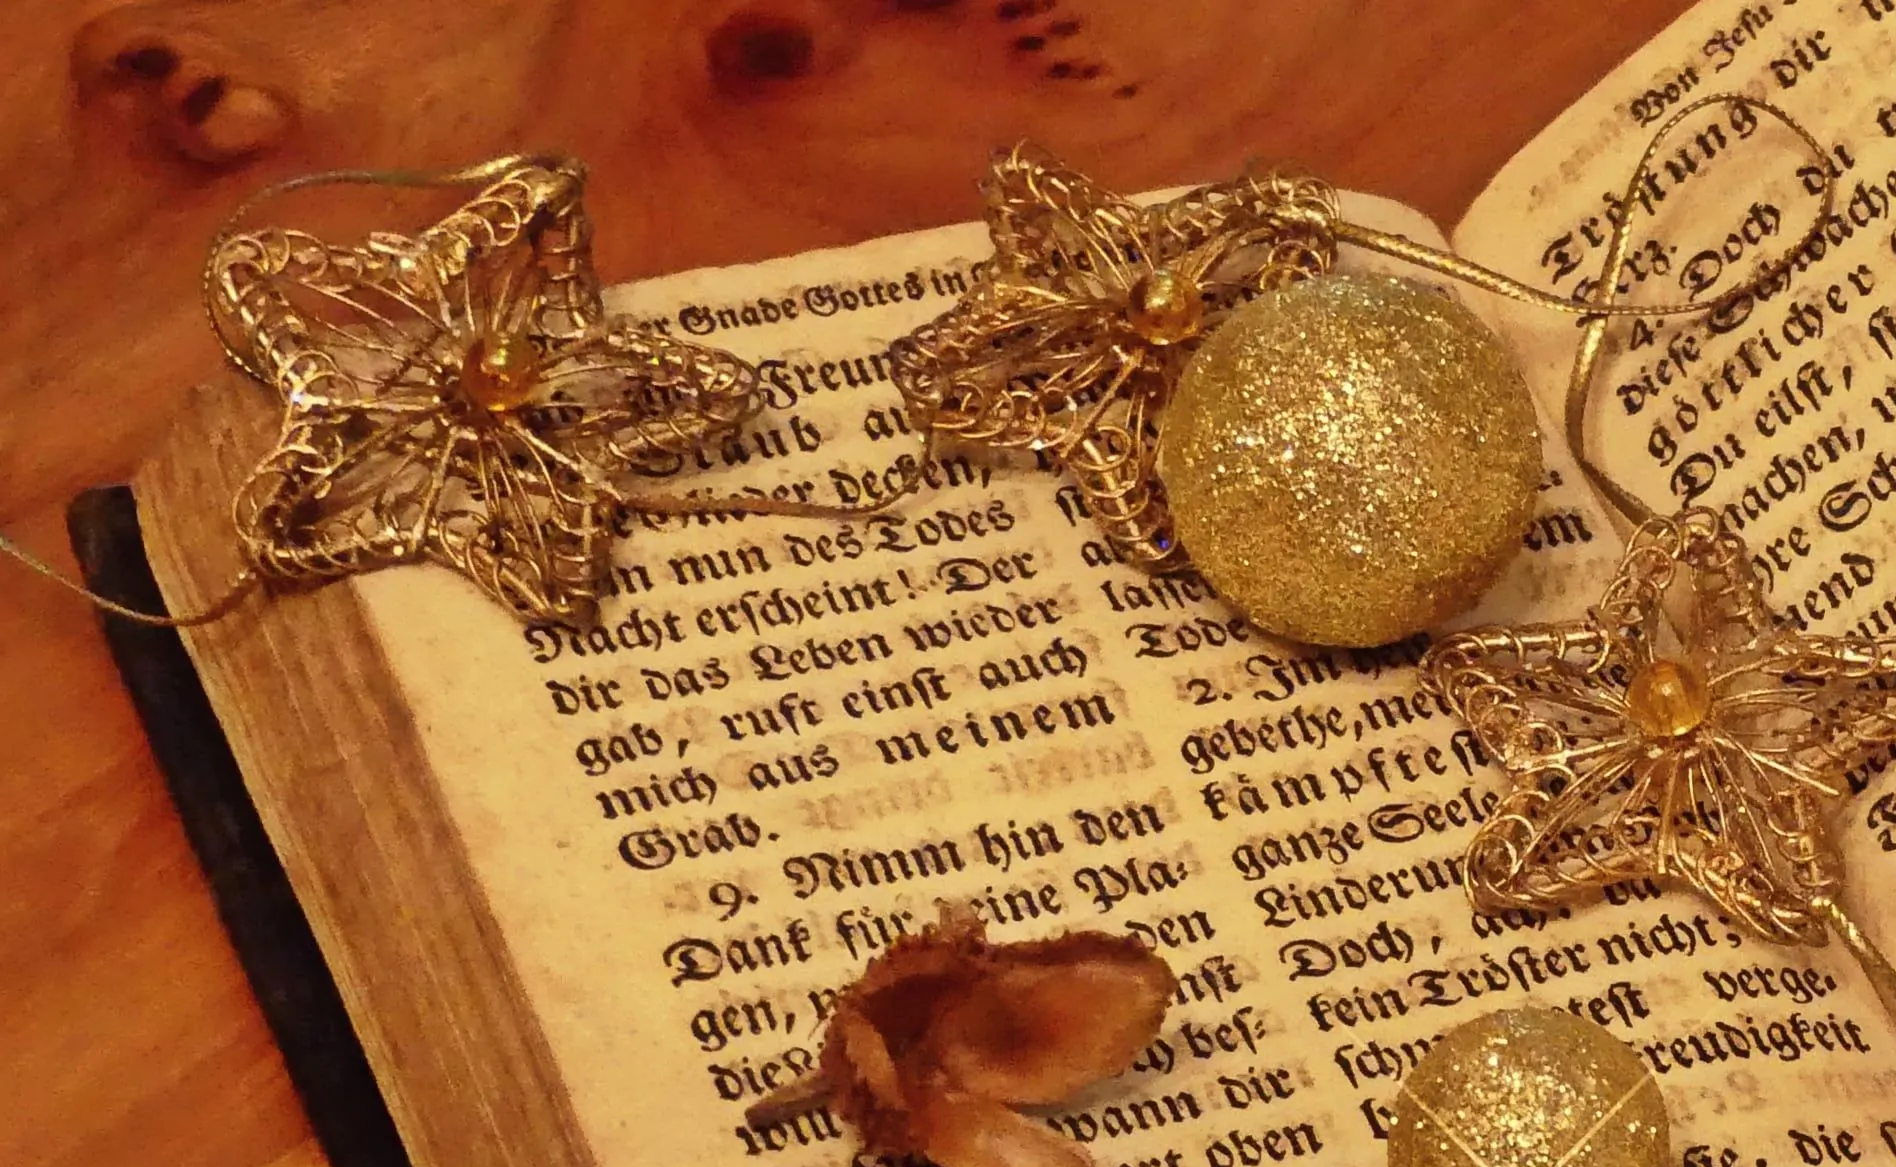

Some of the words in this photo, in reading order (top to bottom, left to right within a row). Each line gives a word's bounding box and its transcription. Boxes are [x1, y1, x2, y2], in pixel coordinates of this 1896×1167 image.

[1769, 29, 1832, 90] dir
[931, 272, 967, 296] in
[668, 545, 771, 586] nun
[783, 523, 864, 567] des
[545, 674, 623, 716] dir
[640, 657, 731, 701] das
[903, 597, 1062, 652] wieder
[719, 691, 822, 741] ruft
[979, 636, 1088, 691] auch
[595, 766, 717, 820] mich
[747, 743, 840, 791] aus
[875, 694, 1116, 765] meinem
[973, 820, 1065, 873] hin
[1072, 803, 1166, 846] den
[1231, 821, 1364, 881] ganze
[1217, 1066, 1295, 1110] dir
[1787, 1123, 1862, 1167] die
